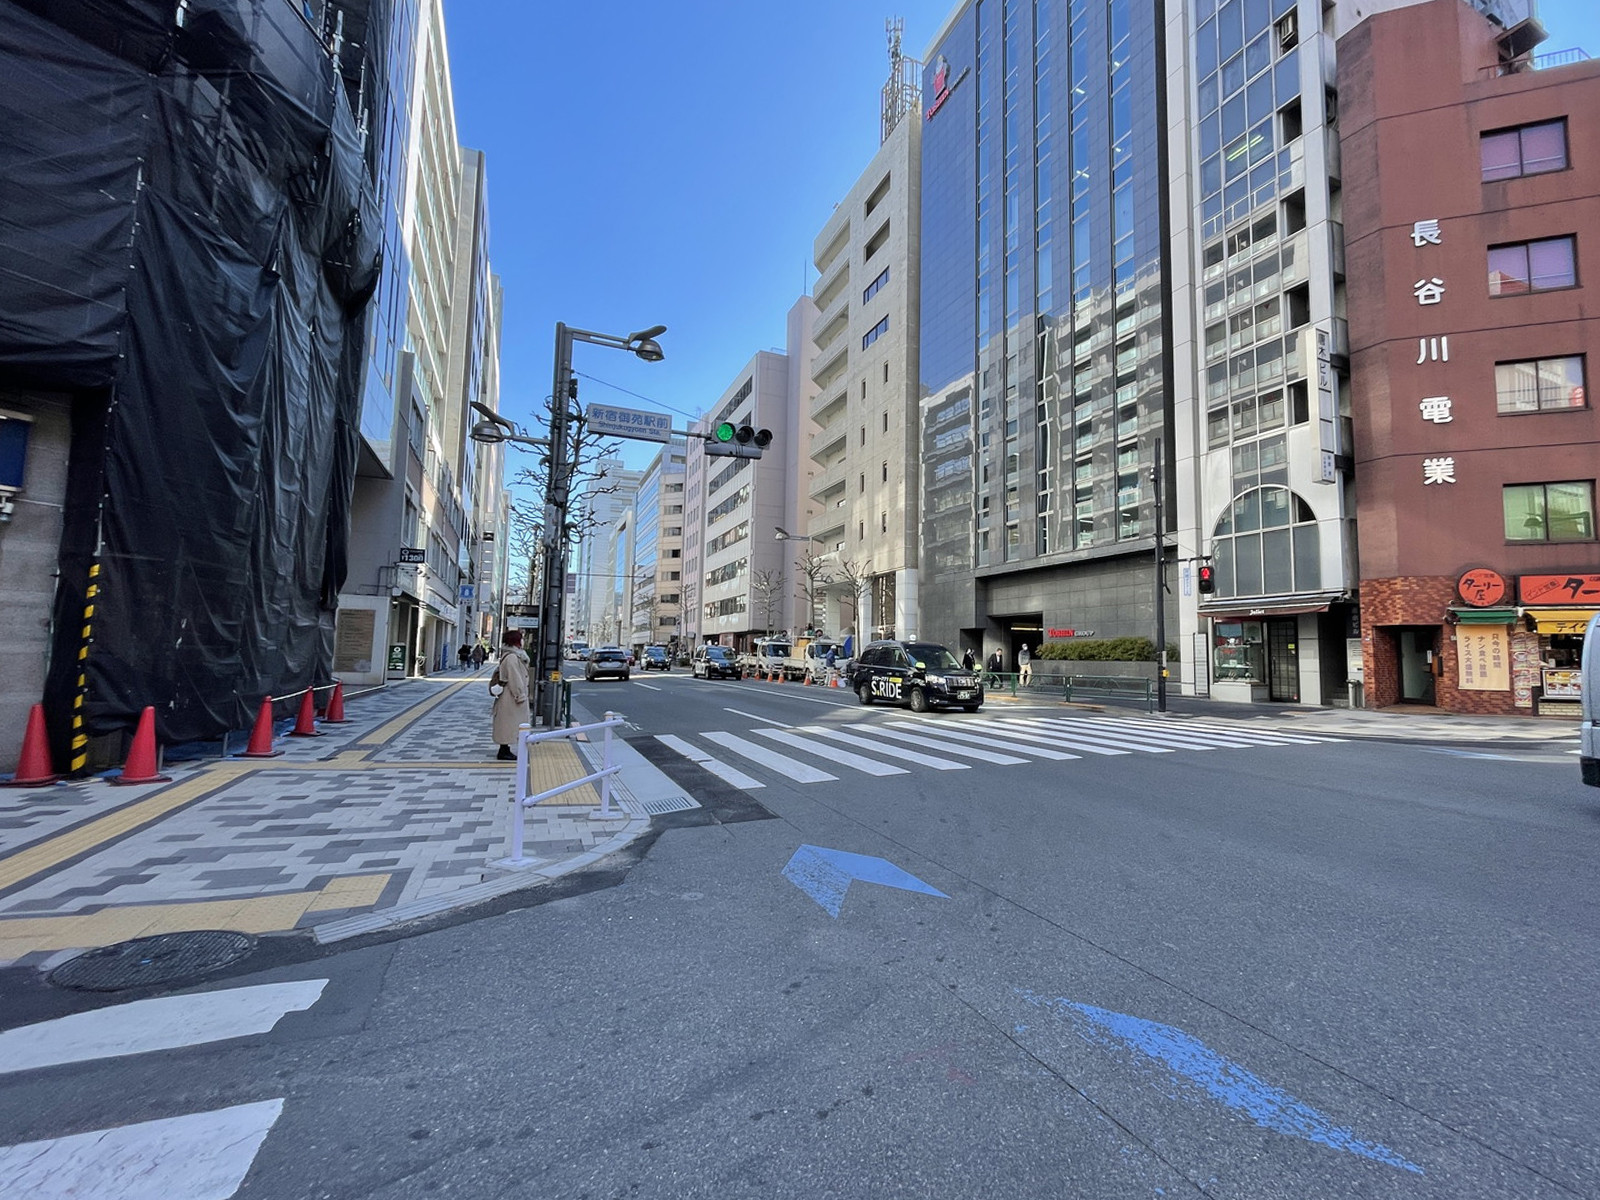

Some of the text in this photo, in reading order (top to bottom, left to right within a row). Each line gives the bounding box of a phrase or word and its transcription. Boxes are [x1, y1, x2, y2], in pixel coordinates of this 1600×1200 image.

[1410, 218, 1457, 486] 長谷川電業
[592, 408, 668, 429] 新宿御苑駅前
[1462, 578, 1501, 591] ターリー
[871, 680, 902, 699] S.RIDE
